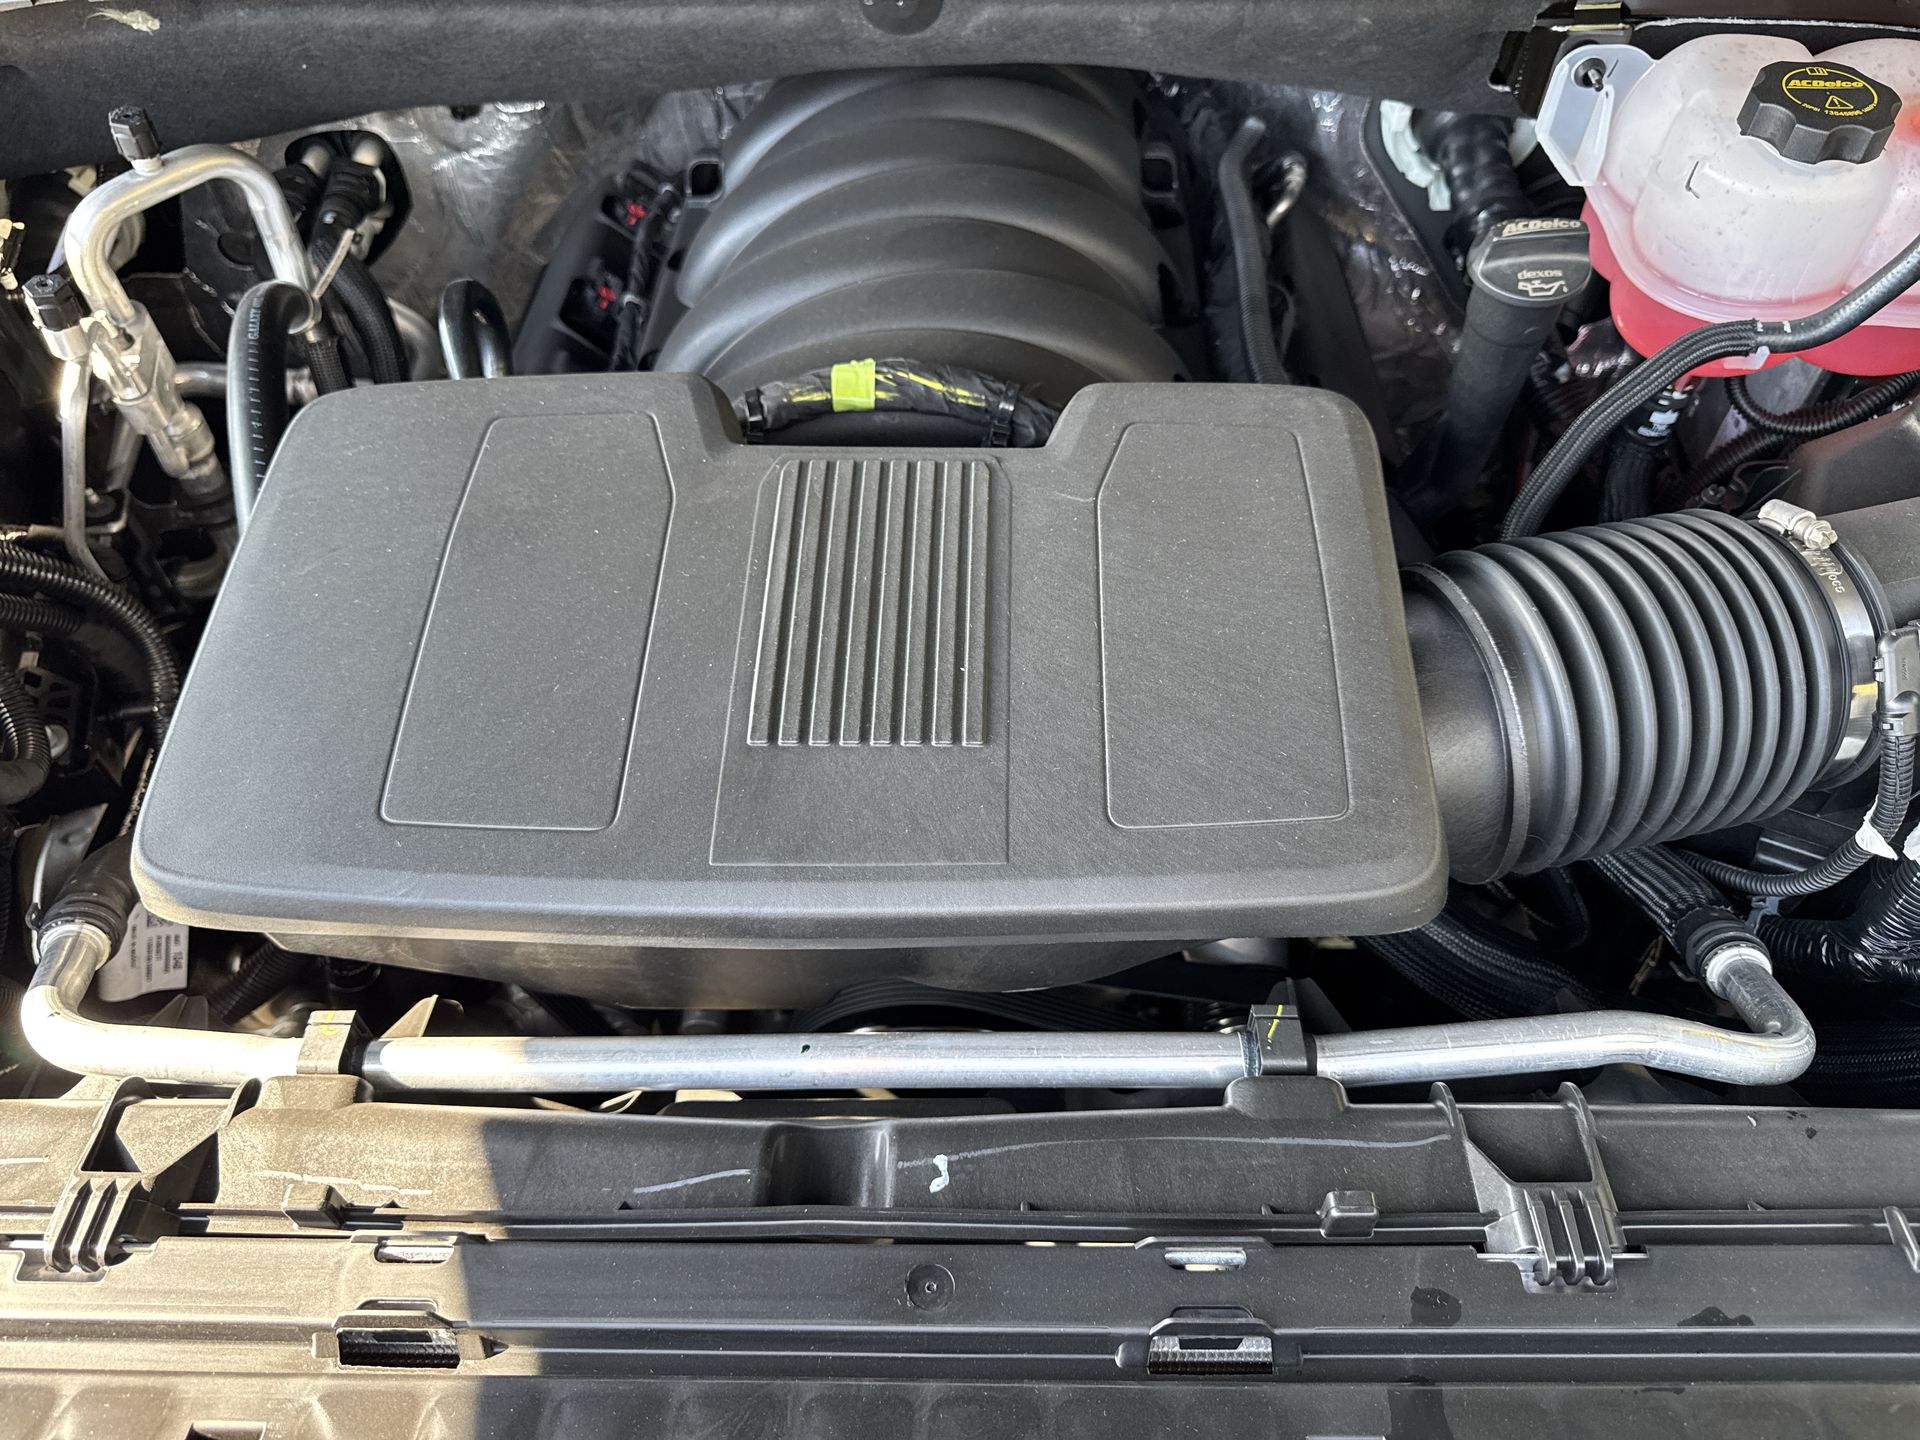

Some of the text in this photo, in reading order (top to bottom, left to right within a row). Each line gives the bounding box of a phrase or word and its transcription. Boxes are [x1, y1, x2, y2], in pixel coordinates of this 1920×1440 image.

[1787, 79, 1864, 88] ACDelco
[1502, 218, 1581, 236] ACDelco
[1517, 269, 1563, 280] dexos
